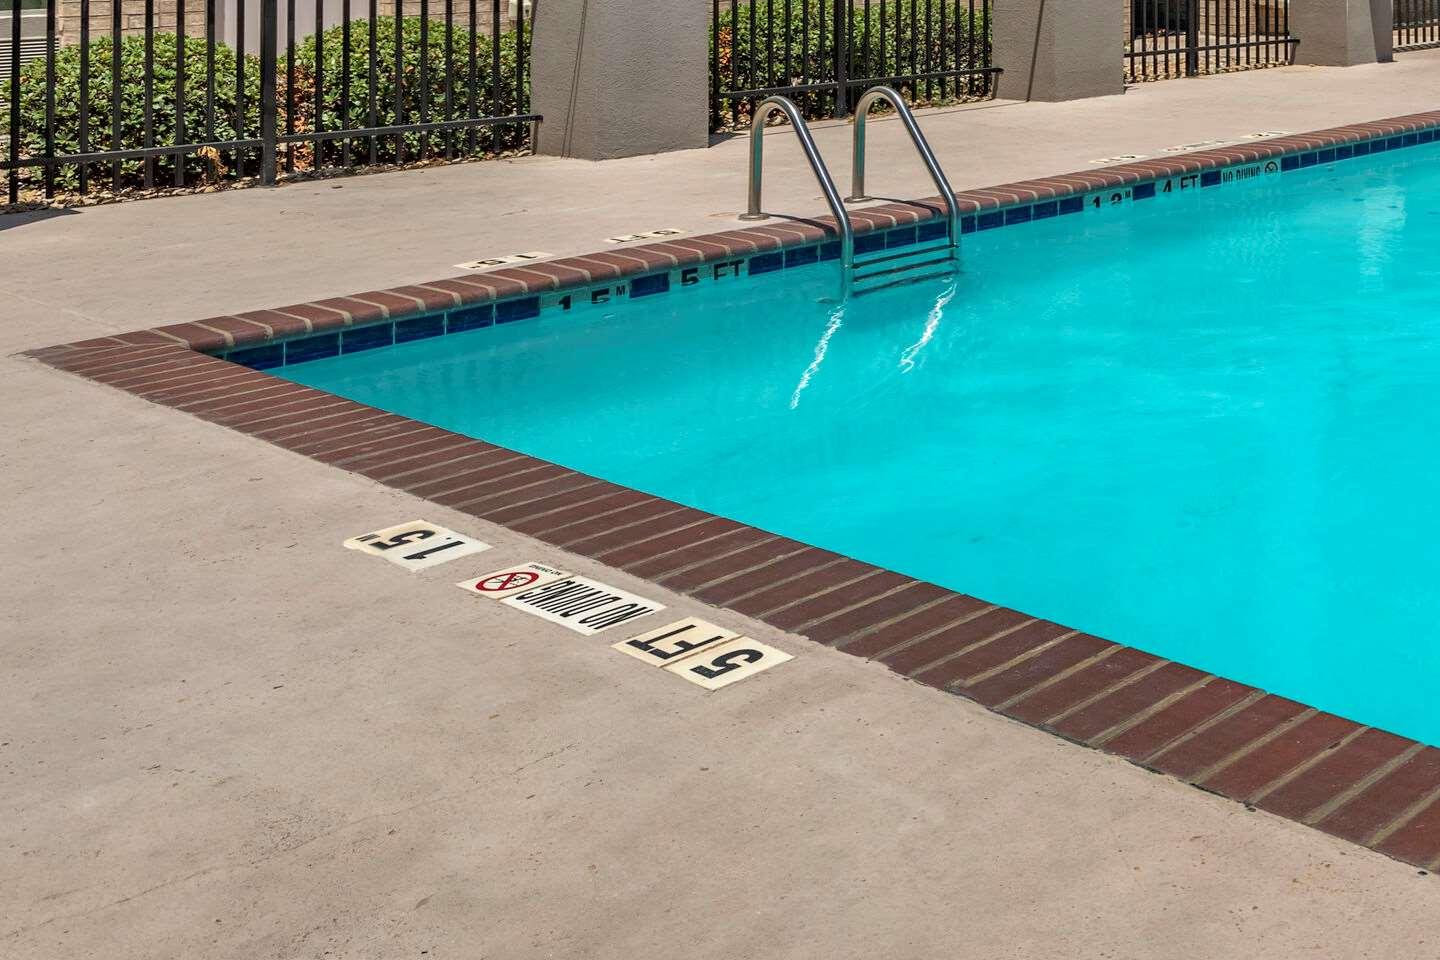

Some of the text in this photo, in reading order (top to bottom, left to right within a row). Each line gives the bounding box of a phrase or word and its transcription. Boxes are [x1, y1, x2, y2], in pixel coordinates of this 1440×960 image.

[713, 259, 746, 281] FT
[515, 579, 654, 630] NO DIVING
[625, 624, 764, 680] 5 FT
